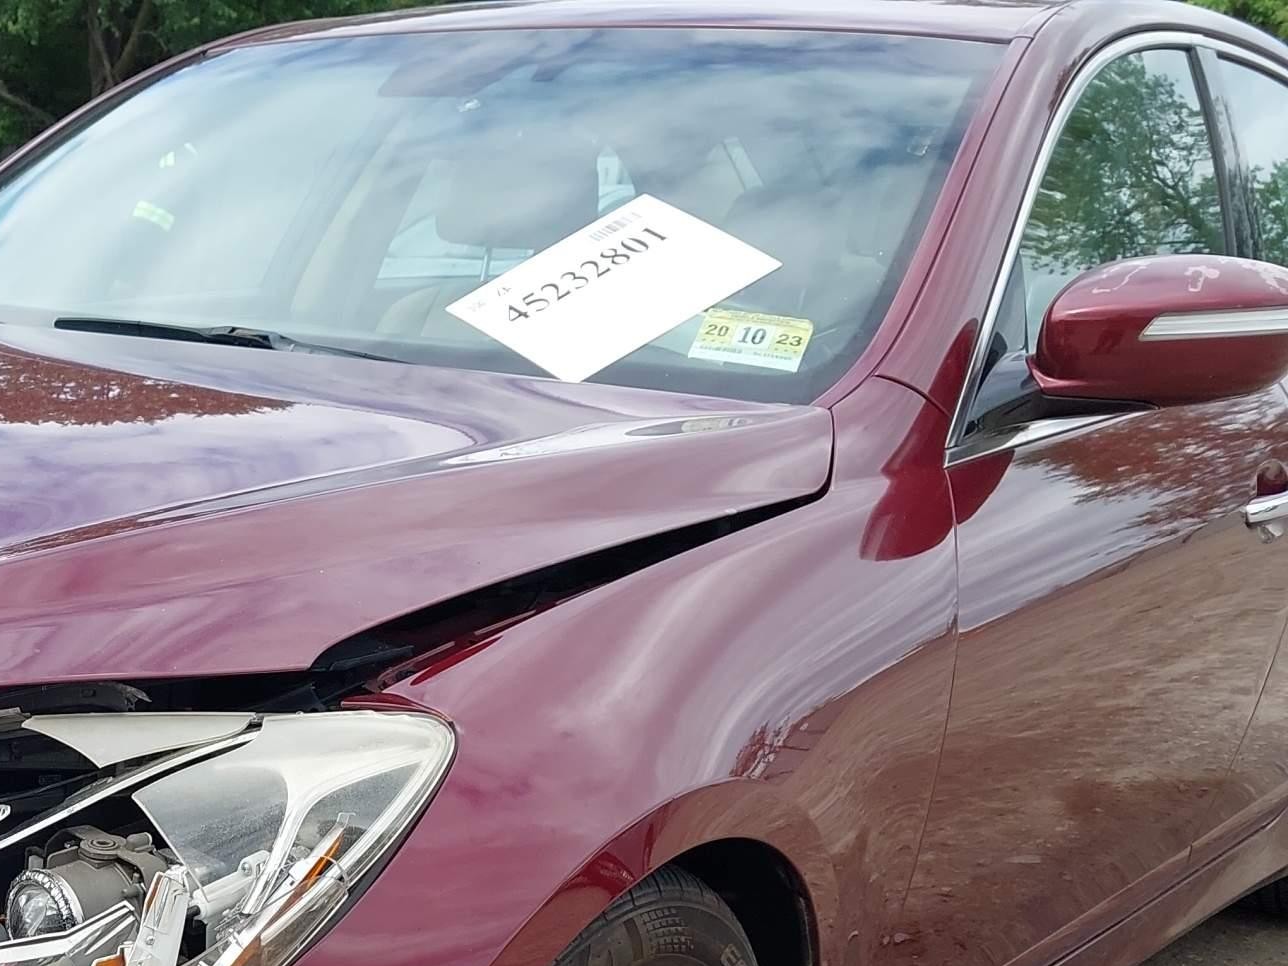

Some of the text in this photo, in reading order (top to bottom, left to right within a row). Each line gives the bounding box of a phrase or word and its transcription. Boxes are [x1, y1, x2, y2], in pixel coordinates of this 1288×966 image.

[508, 227, 668, 322] 45232801
[705, 324, 803, 347] 20 10 23
